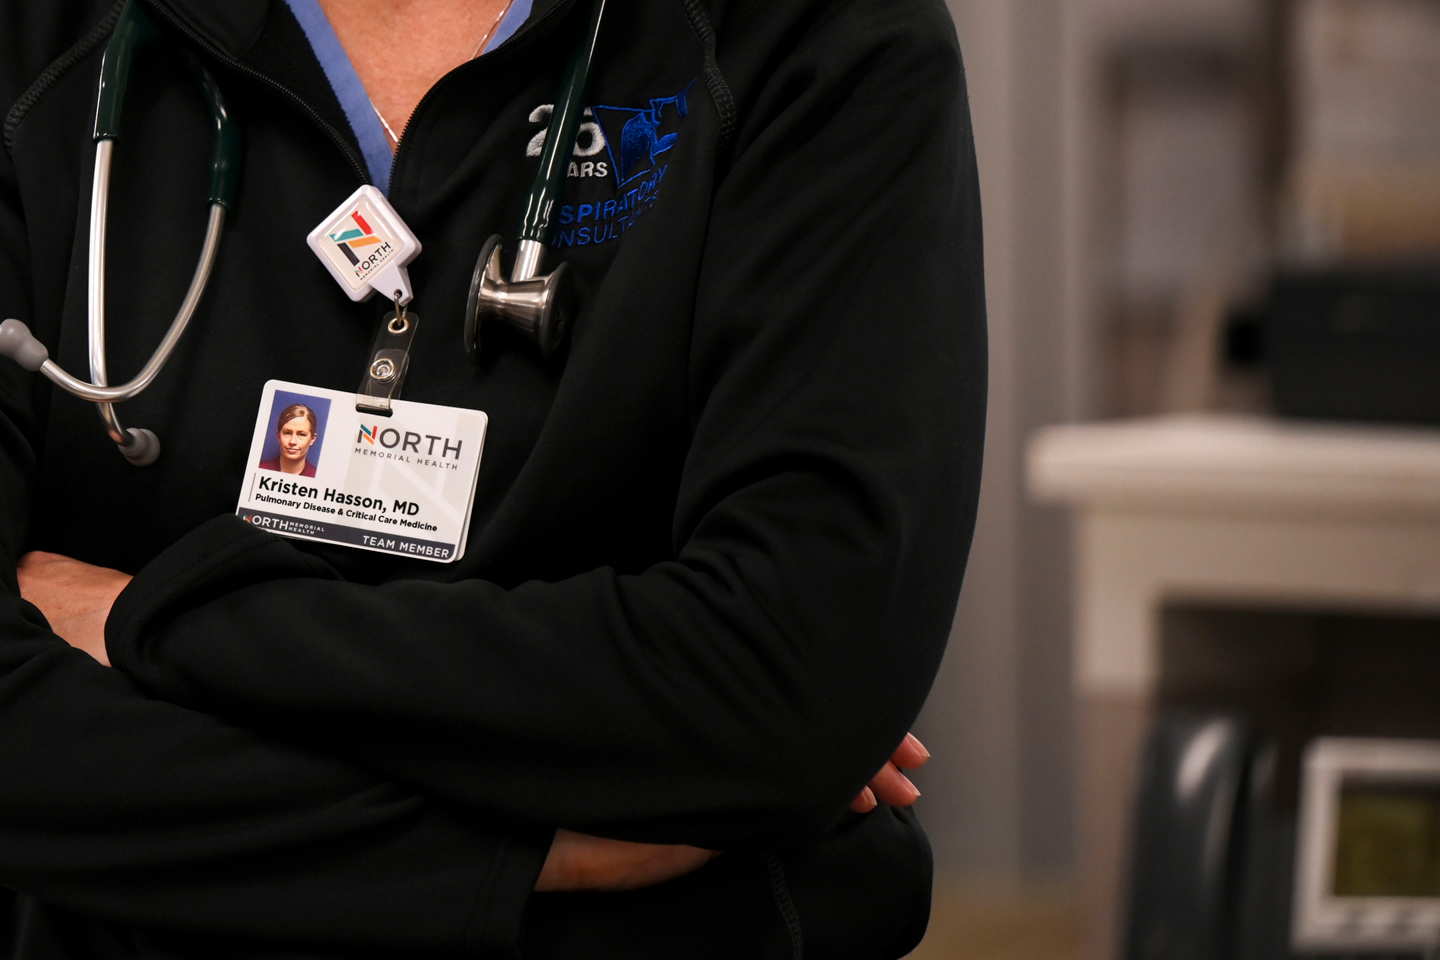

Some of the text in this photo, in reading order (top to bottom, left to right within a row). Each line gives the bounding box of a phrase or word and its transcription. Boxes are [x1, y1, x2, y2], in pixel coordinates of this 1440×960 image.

[567, 161, 608, 178] ARS
[558, 164, 668, 224] SPIRATORY
[354, 241, 391, 277] NORTH
[357, 423, 462, 460] NORTH
[355, 447, 458, 470] MEMORIAL HEALTH
[259, 476, 420, 516] Kristen Hasson, MD
[243, 513, 289, 530] NORTH
[255, 493, 438, 532] Pulmonary Disease & Critical Care Medicine
[288, 526, 315, 535] HEALTH
[289, 521, 325, 532] MEMORIAL
[363, 535, 449, 558] TEAM MEMBER
